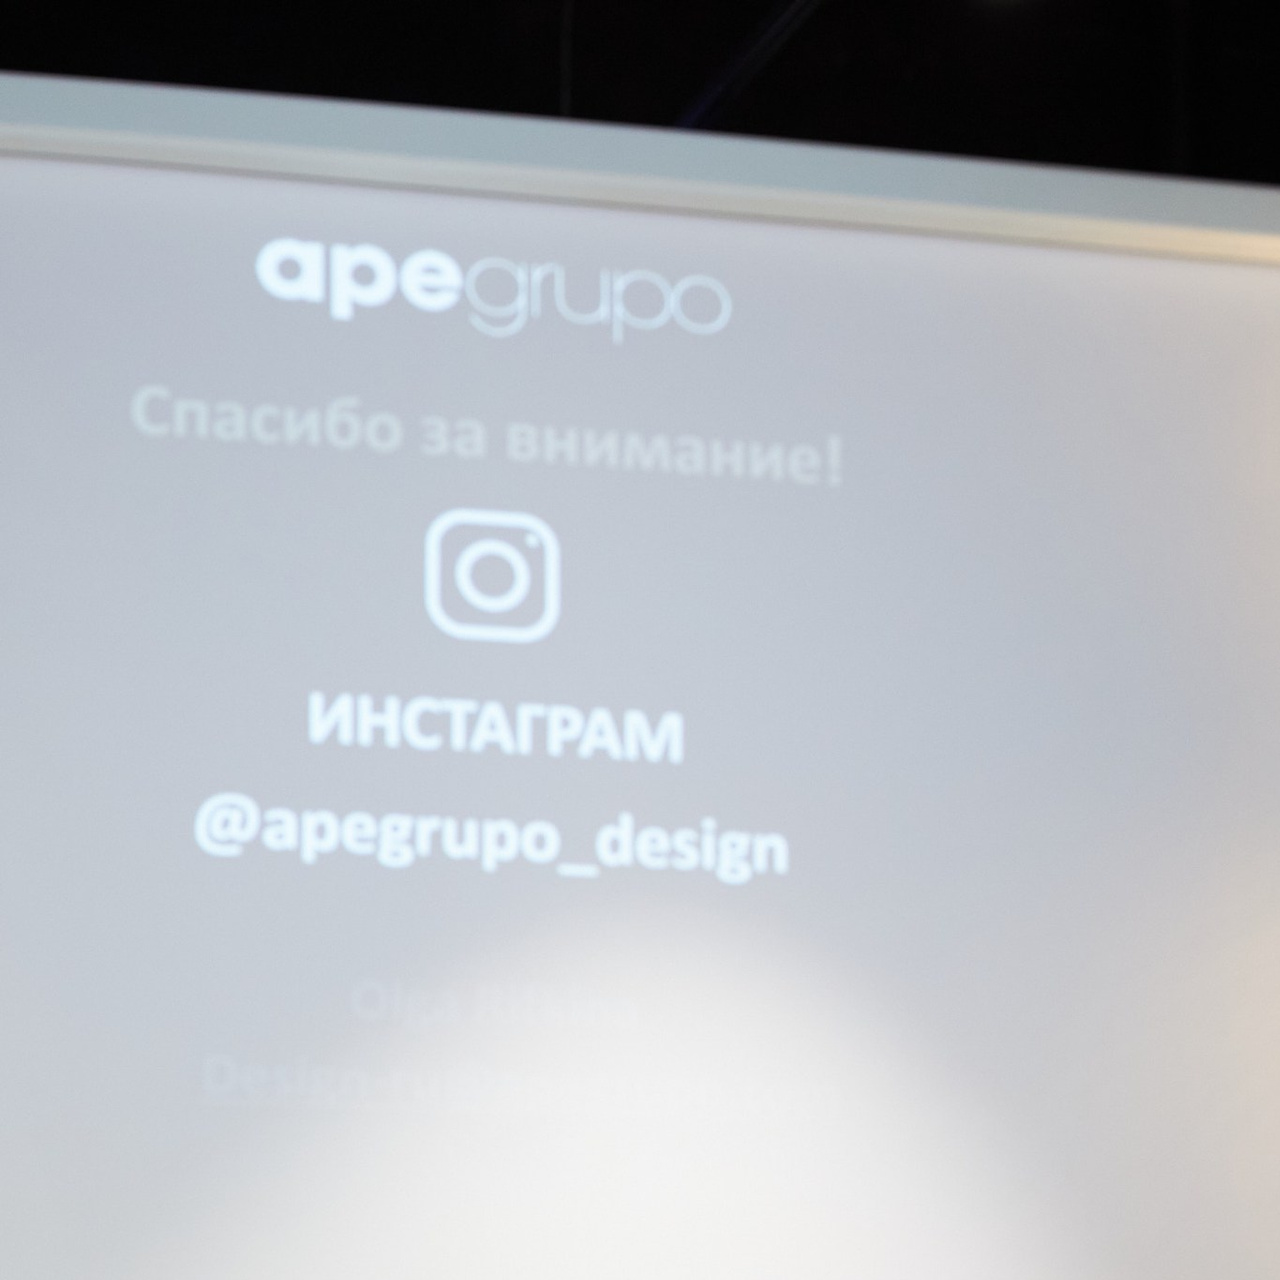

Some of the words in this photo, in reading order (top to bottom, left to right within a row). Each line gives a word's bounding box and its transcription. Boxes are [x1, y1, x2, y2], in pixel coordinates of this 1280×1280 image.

[256, 238, 733, 341] apegrupo
[129, 384, 404, 454] Спасибо
[422, 414, 488, 460] за
[507, 421, 844, 487] внимание!
[308, 691, 685, 763] ИНСТАГРАМ
[193, 792, 790, 884] @apegrupo_design
